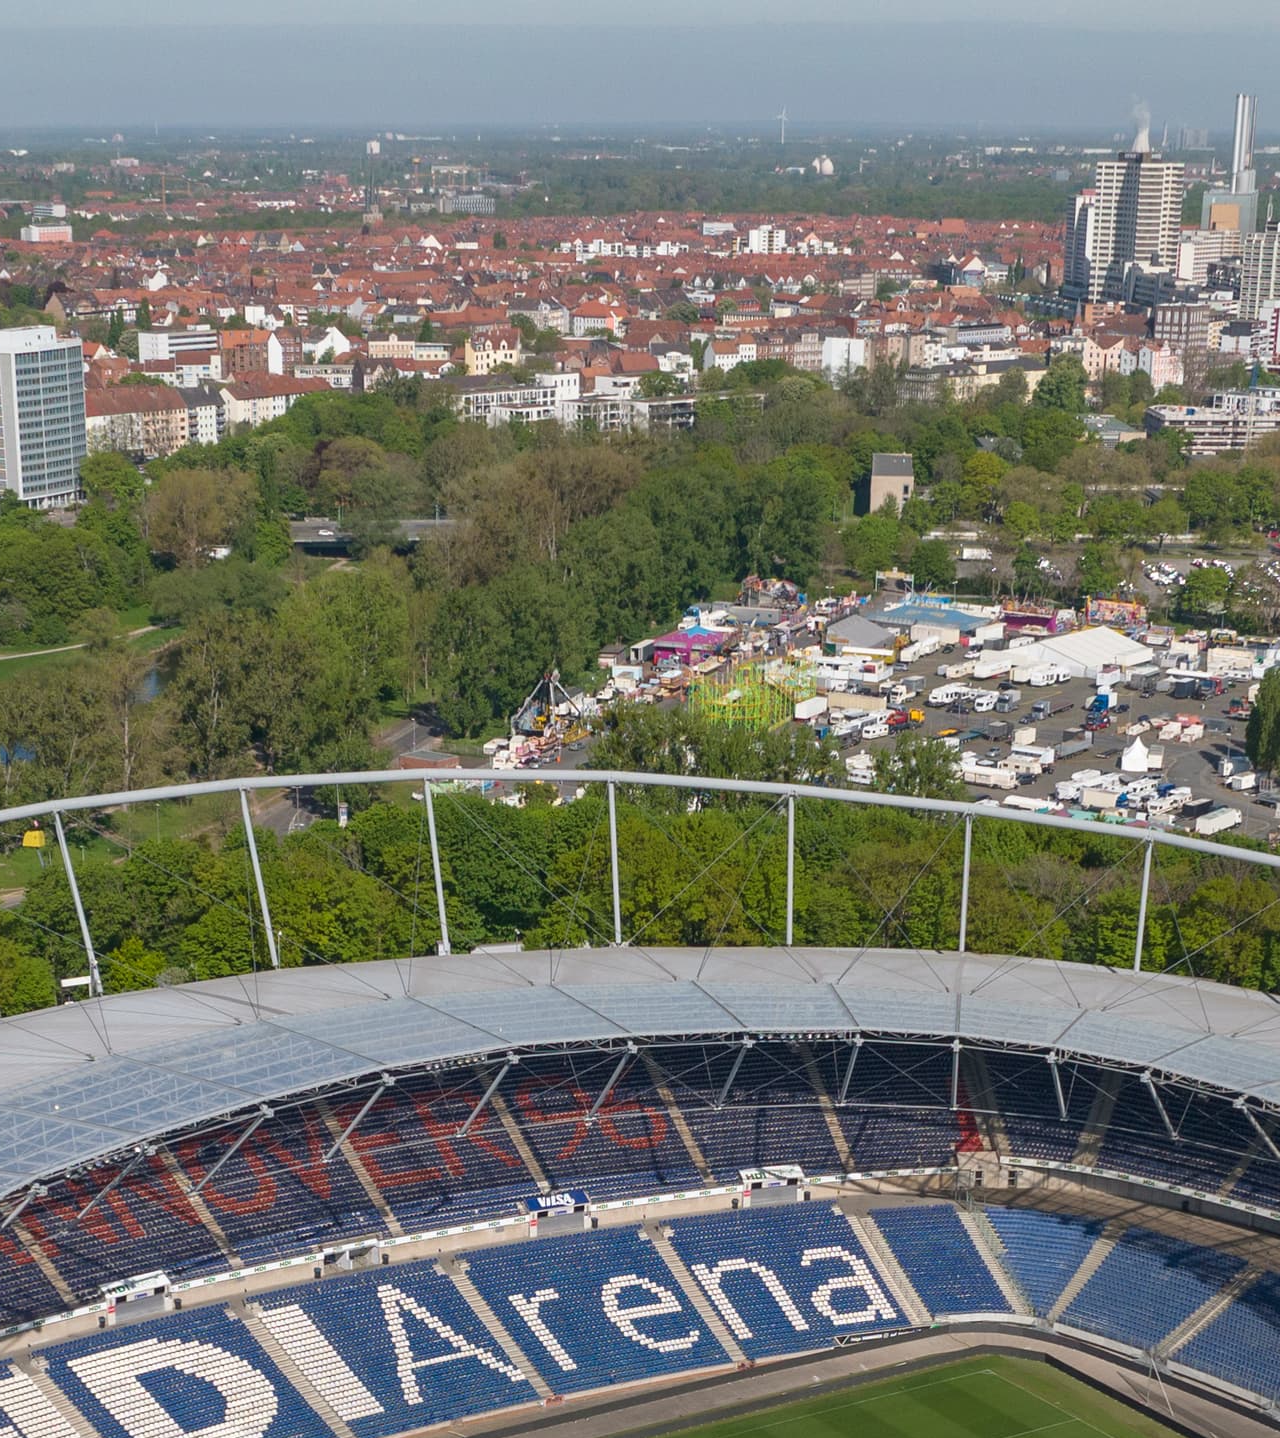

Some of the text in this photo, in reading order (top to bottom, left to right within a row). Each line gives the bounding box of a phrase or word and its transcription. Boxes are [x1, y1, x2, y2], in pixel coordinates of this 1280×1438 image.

[516, 1076, 667, 1161] 96
[745, 1170, 767, 1180] HDI
[537, 1193, 575, 1208] VILSA
